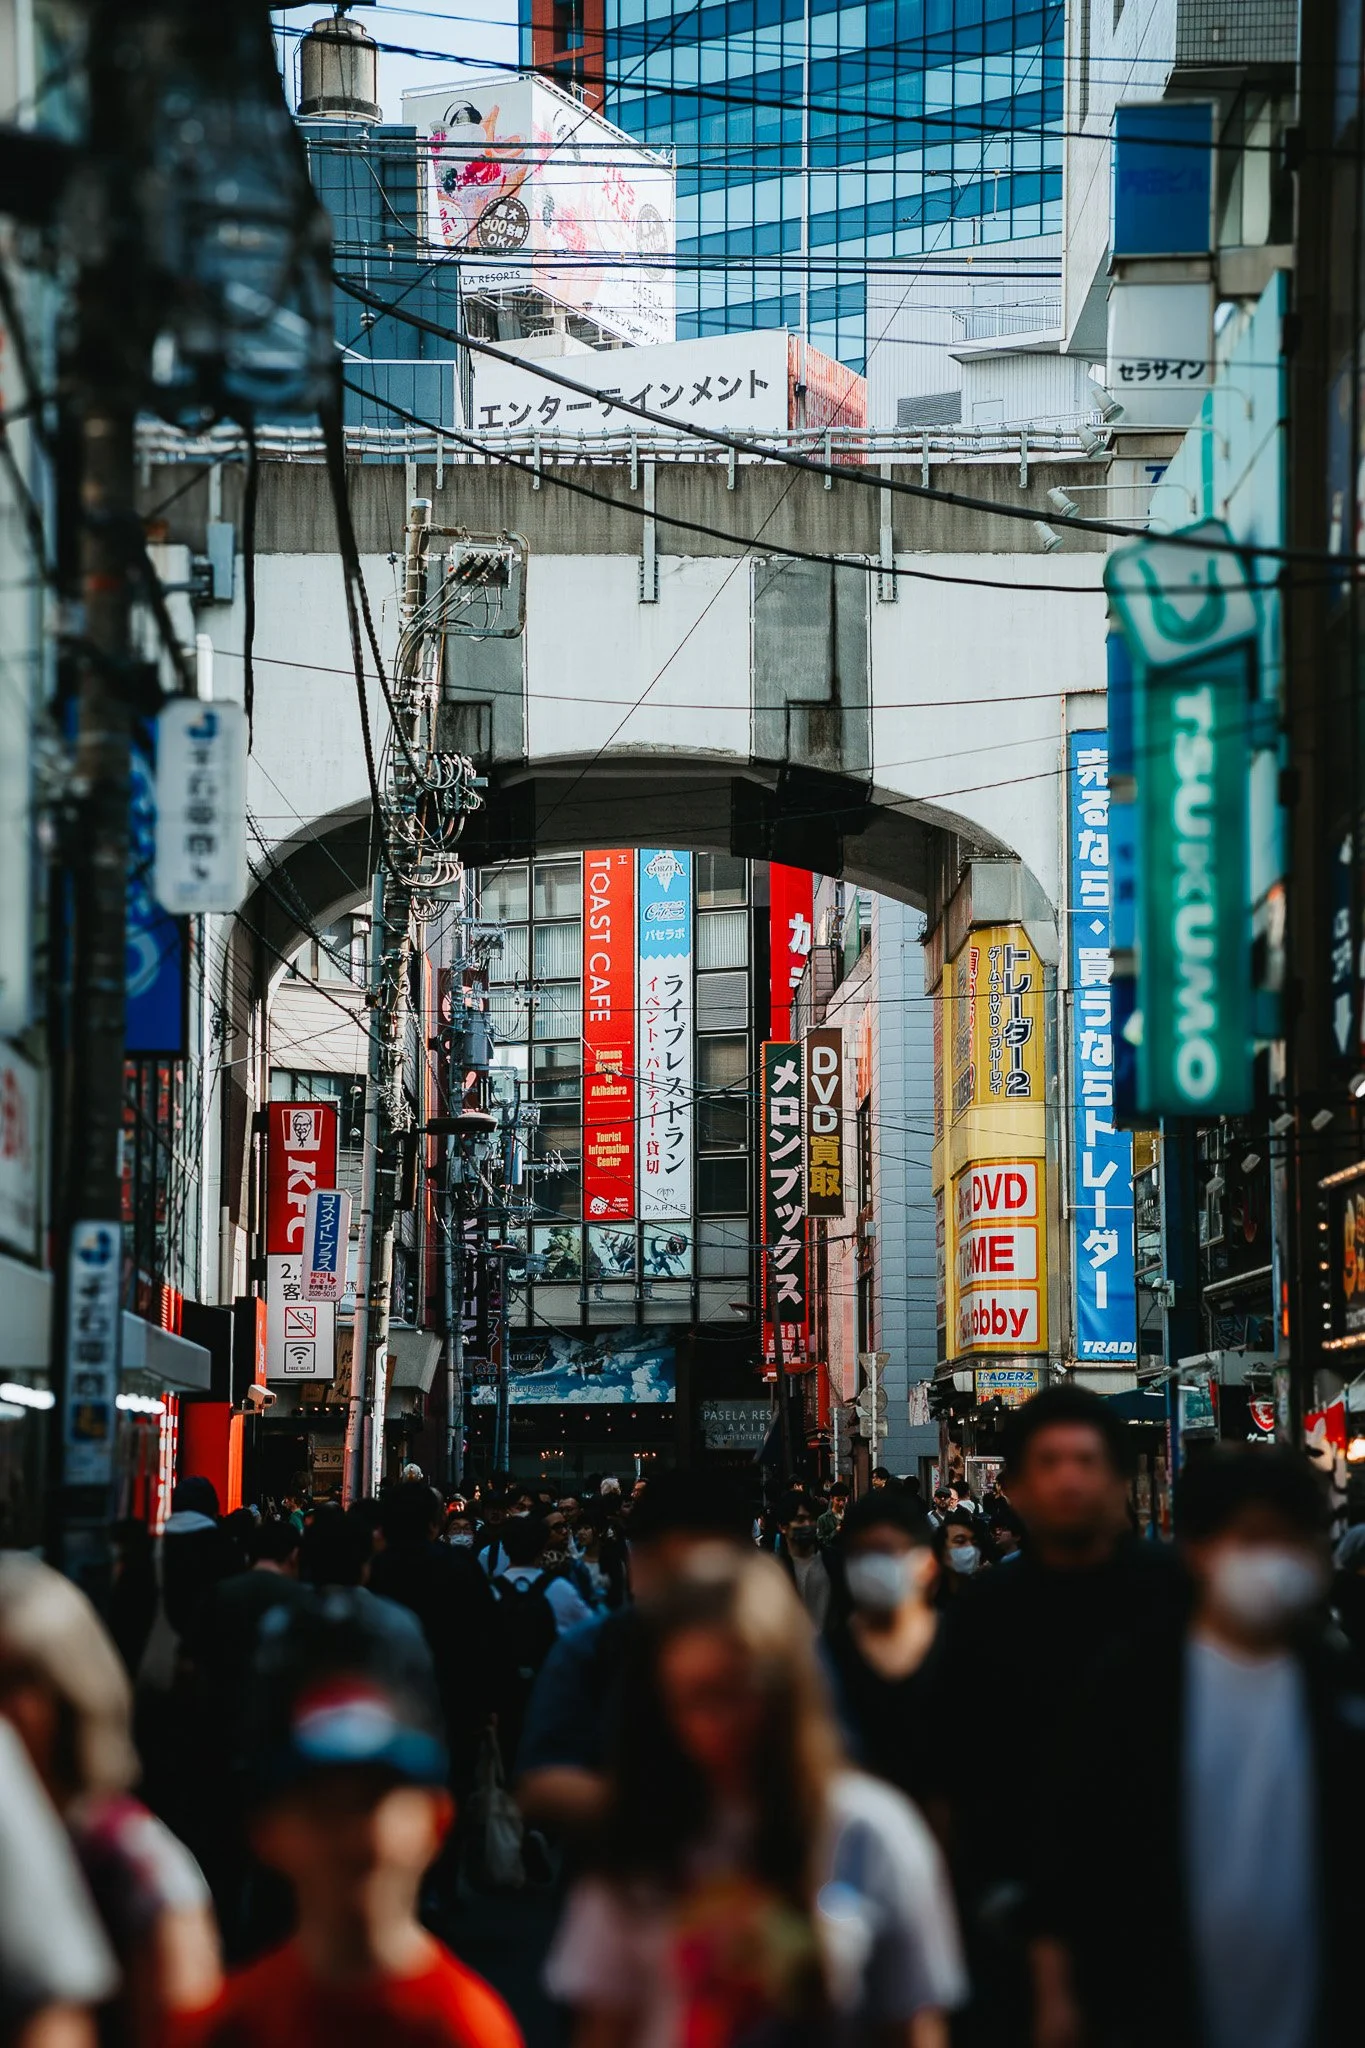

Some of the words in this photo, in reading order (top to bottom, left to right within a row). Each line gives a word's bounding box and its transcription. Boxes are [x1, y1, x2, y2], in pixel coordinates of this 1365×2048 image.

[487, 234, 513, 248] OK!
[478, 270, 520, 284] RESORTS
[1118, 360, 1205, 381] セラサイン
[478, 369, 769, 429] エンターテインメント
[589, 857, 611, 943] TOAST
[1171, 687, 1221, 1101] TSUKUMO
[644, 928, 686, 941] パセラボ
[589, 952, 611, 1022] CAFE
[1003, 944, 1033, 1097] トレーダー2
[595, 1049, 623, 1060] Famous
[645, 976, 661, 1174] イベント・パーティー・貸切
[664, 974, 686, 1175] ライブレストラン
[591, 1085, 627, 1097] Akihabara
[810, 1046, 841, 1197] DVD買取
[588, 1144, 630, 1155] Information
[596, 1132, 622, 1143] Tourist
[597, 1156, 622, 1167] Center
[769, 1059, 804, 1304] メロンブックス
[973, 1173, 1028, 1212] DVD
[287, 1156, 316, 1243] KFC
[316, 1194, 336, 1271] コスメイトプラス
[283, 1283, 304, 1301] 客
[978, 1371, 1035, 1381] TRADER2
[704, 1410, 746, 1421] PASELA
